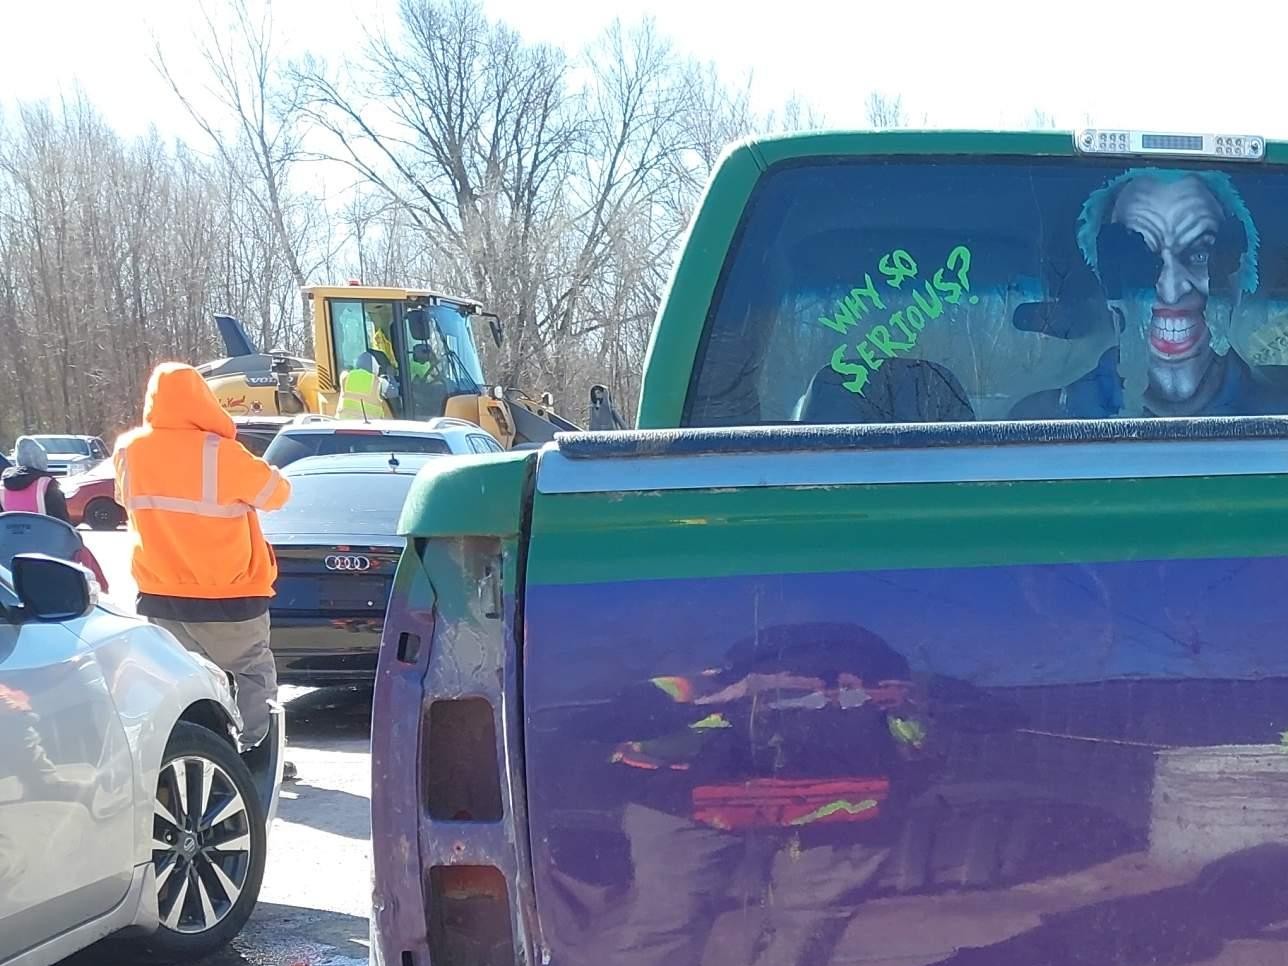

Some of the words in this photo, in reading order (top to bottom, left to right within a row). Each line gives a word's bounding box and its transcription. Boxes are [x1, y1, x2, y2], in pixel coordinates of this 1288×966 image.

[818, 272, 887, 335] WHY
[878, 249, 918, 290] SO
[831, 245, 979, 399] SERIOUS?
